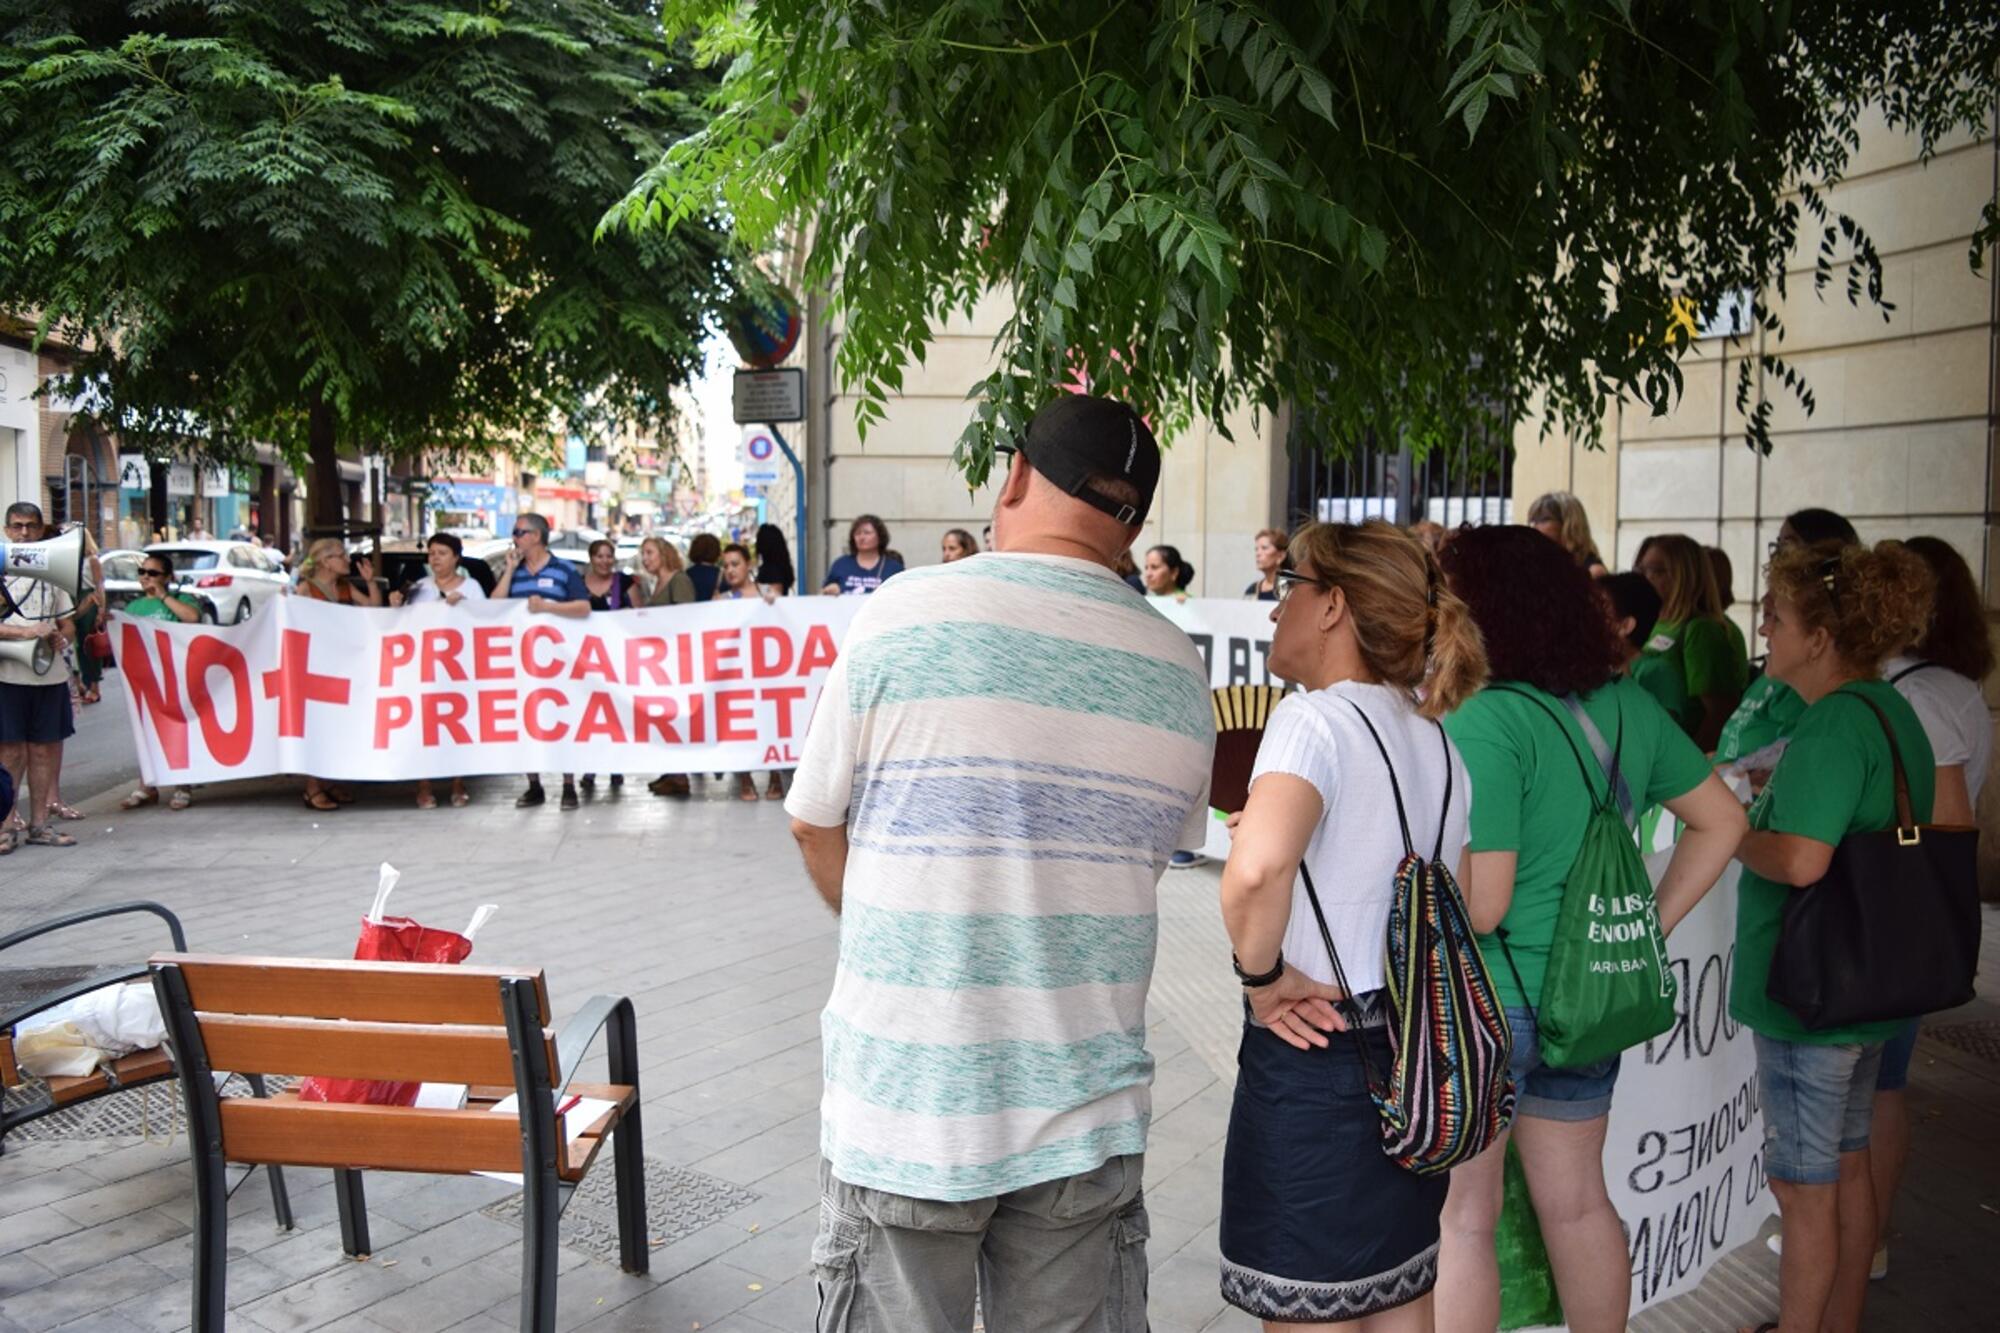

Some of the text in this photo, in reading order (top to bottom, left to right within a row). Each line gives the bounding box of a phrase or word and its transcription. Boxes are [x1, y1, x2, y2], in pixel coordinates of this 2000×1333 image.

[378, 625, 838, 687] PRECARIEDA
[373, 686, 823, 750] PRECARIET
[763, 744, 799, 763] AL
